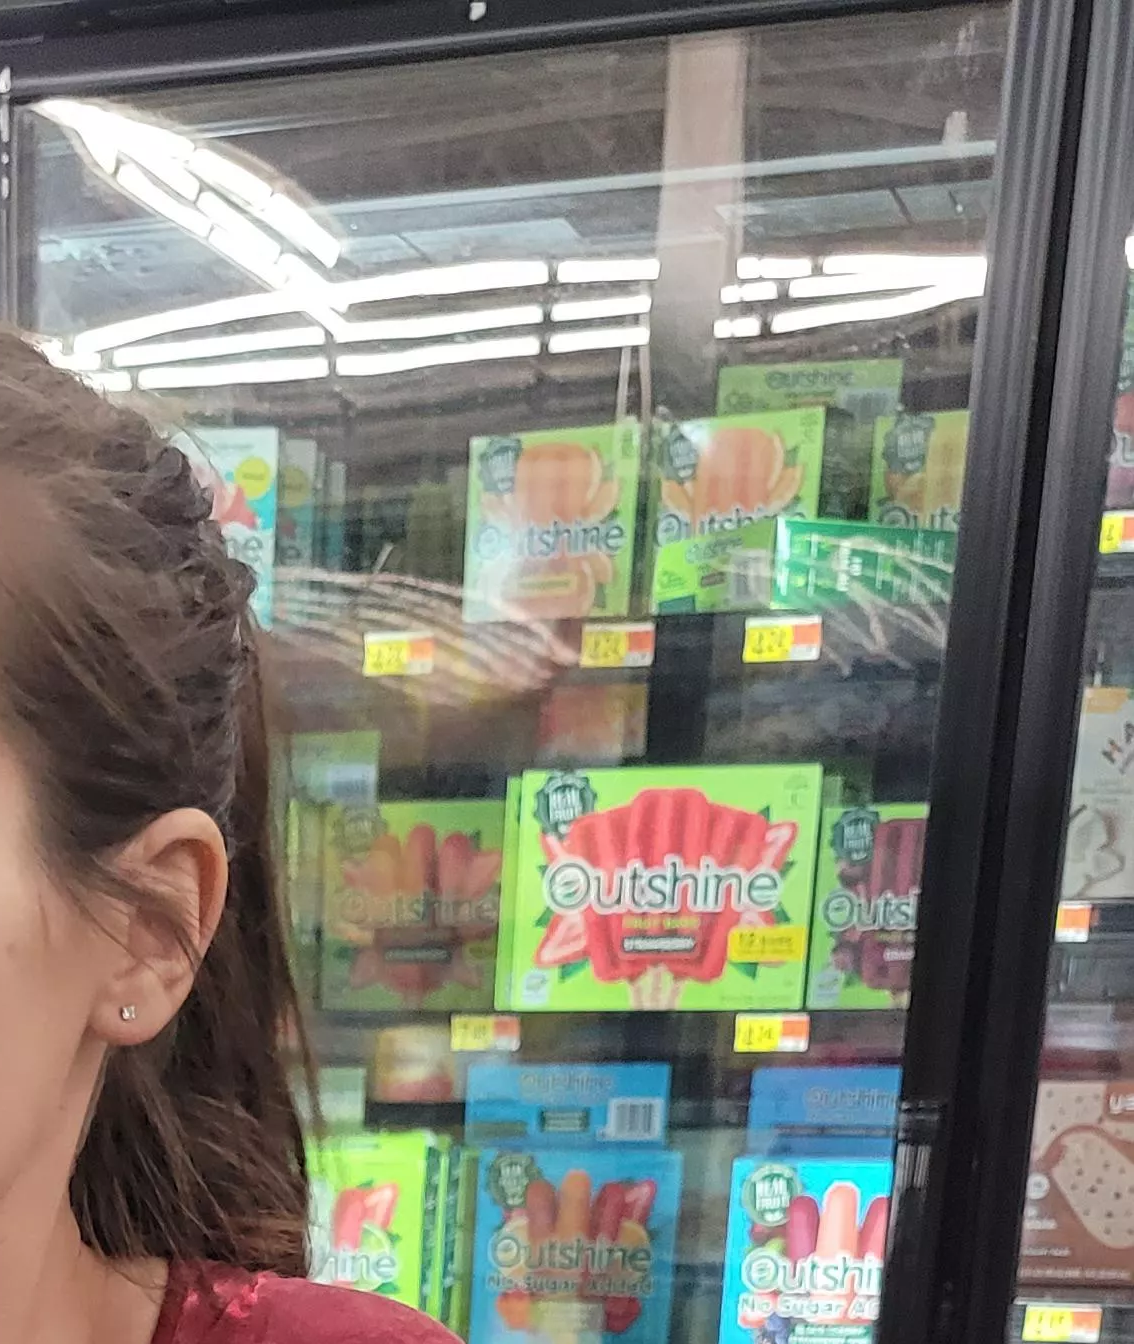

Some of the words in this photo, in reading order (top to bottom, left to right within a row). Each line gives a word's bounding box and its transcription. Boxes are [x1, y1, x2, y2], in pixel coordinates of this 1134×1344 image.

[546, 856, 781, 912] Outshine
[488, 1236, 652, 1273] Outshine
[523, 1275, 579, 1293] Sugar
[741, 1294, 773, 1316] No
[778, 1295, 843, 1318] Sugar
